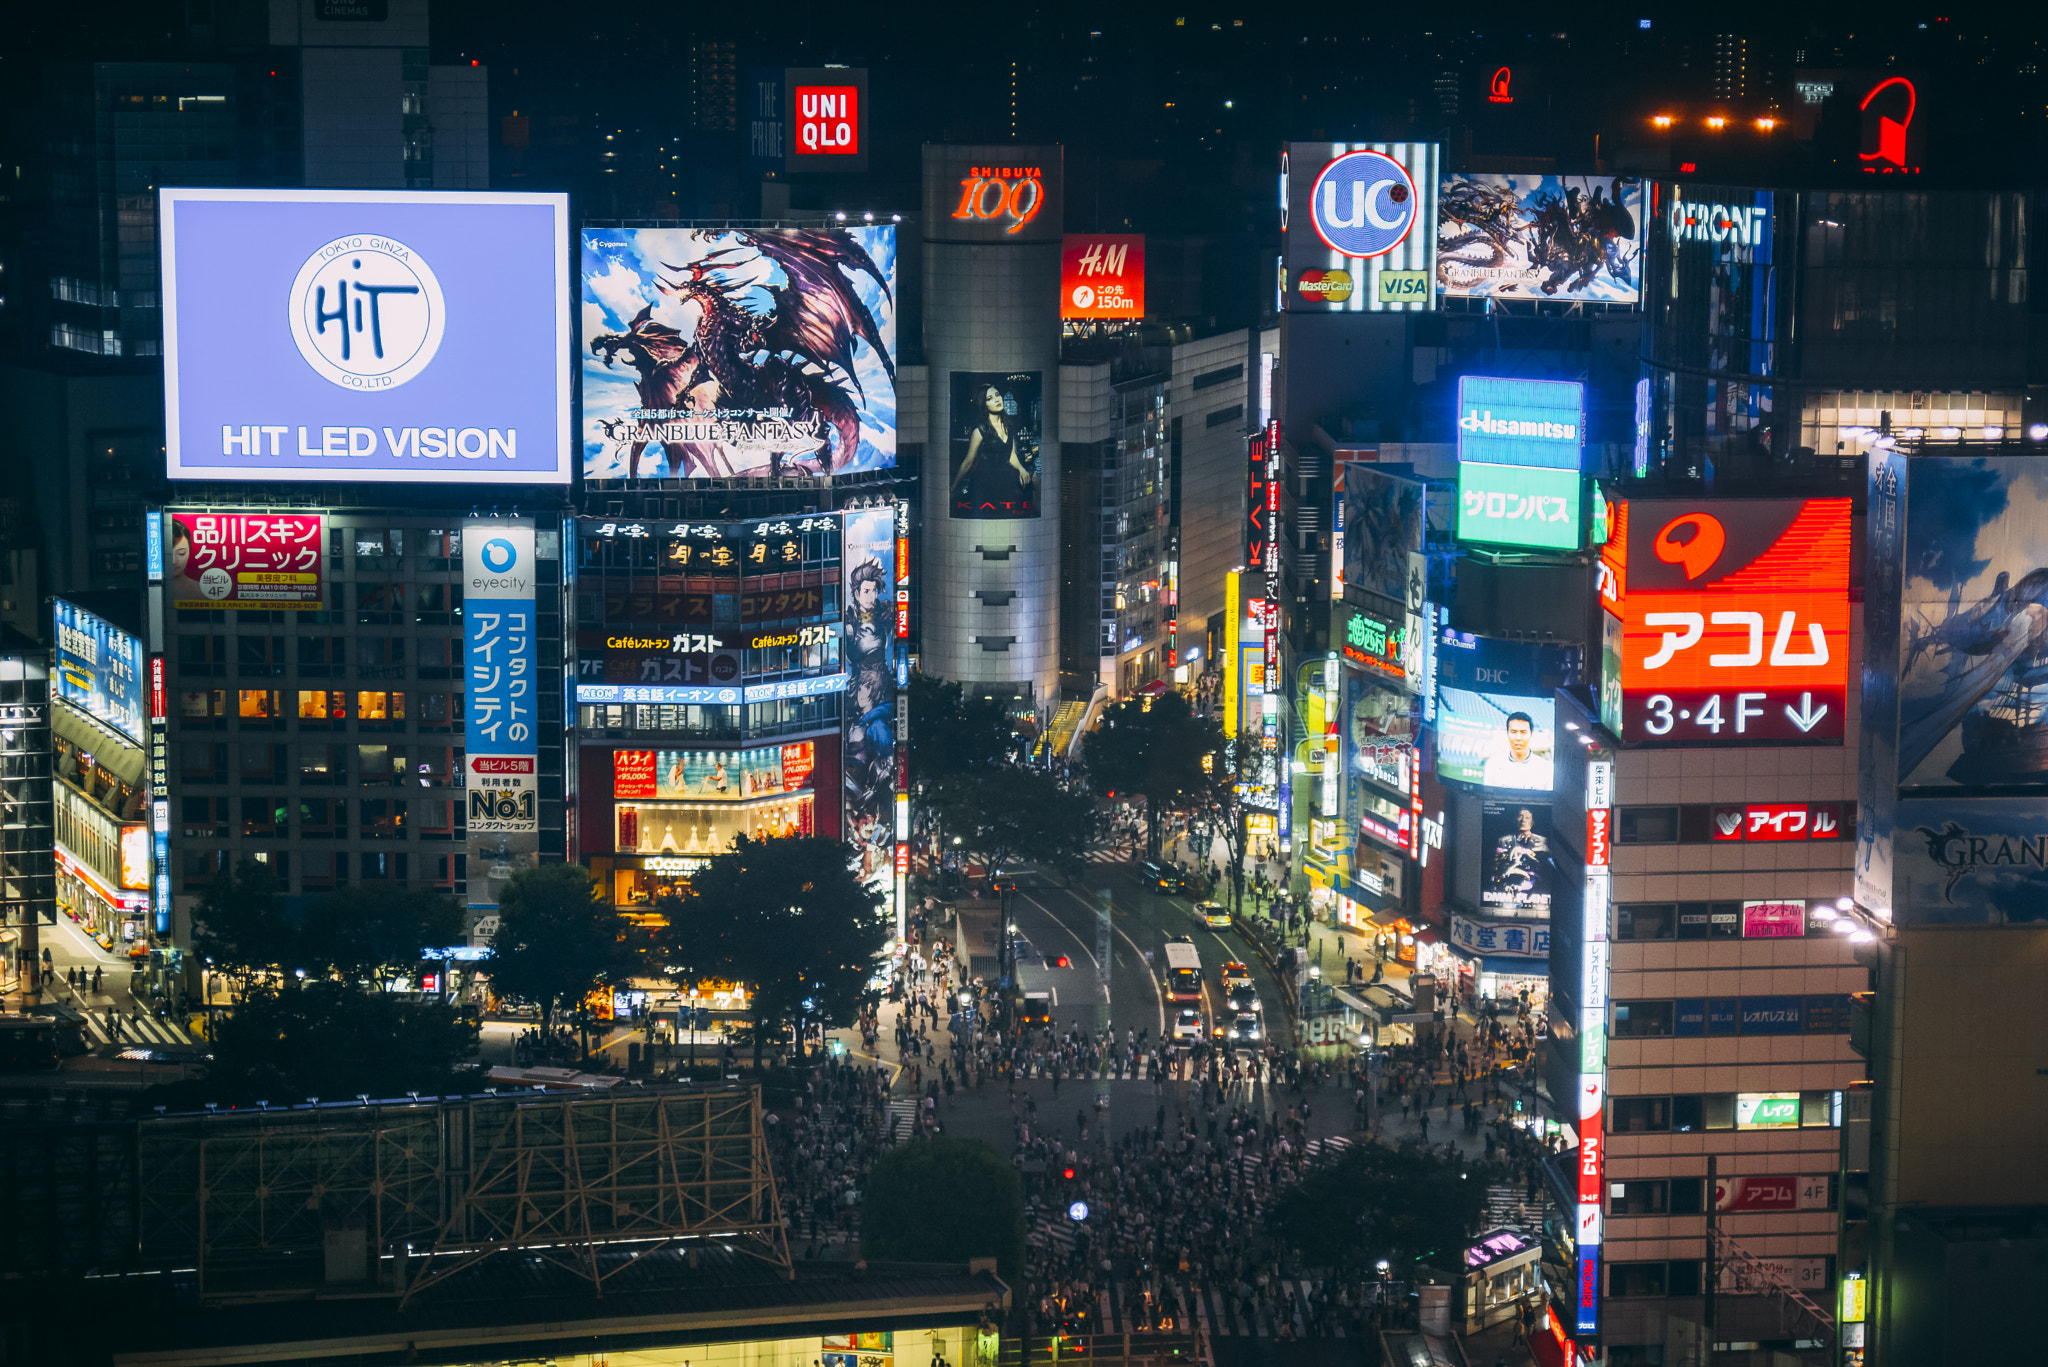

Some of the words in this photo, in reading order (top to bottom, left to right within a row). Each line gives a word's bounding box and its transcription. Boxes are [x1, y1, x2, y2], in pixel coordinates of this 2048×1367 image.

[758, 81, 777, 118] THE
[802, 94, 848, 118] UNI
[751, 120, 783, 158] PRIME
[802, 122, 852, 150] QLO
[969, 167, 1042, 178] SHIBUYA
[951, 178, 1045, 235] 109
[317, 238, 362, 261] TOKYO
[369, 238, 410, 262] GINZA
[599, 240, 628, 249] Cygames
[1078, 243, 1129, 277] H&M
[1448, 268, 1496, 279] GRANBLUE
[1498, 268, 1541, 280] FANTASY
[1097, 285, 1125, 296] この先
[1299, 279, 1353, 293] MasterCard
[1385, 278, 1427, 294] VISA
[1097, 296, 1134, 309] 150m
[341, 374, 395, 389] CO.,LTD.
[609, 420, 718, 442] GRANBLUE
[725, 414, 824, 446] FANTASY
[1459, 410, 1576, 439] Hisamitsu
[222, 425, 289, 456] HIT
[297, 426, 377, 457] LED
[382, 427, 516, 459] VISION
[1463, 490, 1570, 524] サロンパス
[193, 517, 318, 544] 品川スキン
[194, 545, 318, 570] クリニック
[202, 575, 229, 584] 当ビル
[256, 574, 298, 583] 美容皮フ科
[472, 576, 526, 592] eyecity
[1597, 560, 1617, 602] アコム
[208, 587, 225, 596] 4F
[740, 590, 820, 616] コンタクト
[607, 636, 670, 650] Caféレストラン
[672, 635, 723, 653] ガスト
[799, 625, 836, 646] ガスト
[1643, 610, 1830, 670] アコム
[473, 612, 501, 742] アイシティ
[508, 613, 528, 742] コンタクトの
[579, 660, 604, 674] 7F
[1475, 667, 1509, 684] DHC
[582, 689, 612, 699] AEON
[622, 688, 714, 701] 英会話イーオン
[748, 688, 772, 699] AEON
[776, 678, 845, 698] 英会話イーオン
[1603, 669, 1622, 711] レイク
[479, 760, 530, 771] 当ビル5階
[617, 754, 650, 766] ハワイ
[481, 778, 521, 786] 利用者数
[469, 789, 535, 820] No.1
[468, 822, 535, 830] コンタクトショップ
[1749, 811, 1836, 833] アイフル
[1591, 822, 1606, 865] アイフル
[1936, 836, 2048, 871] GRAN
[1453, 919, 1550, 951] 大盛堂書店
[1749, 923, 1799, 936] 高価買取
[1587, 1031, 1600, 1068] レイク
[1763, 1104, 1795, 1117] レイク
[1583, 1138, 1597, 1175] アコム
[1746, 1186, 1793, 1202] アコム
[1803, 1185, 1825, 1200] 4F
[1582, 1259, 1594, 1308] PROMISE
[1801, 1267, 1823, 1282] 3F
